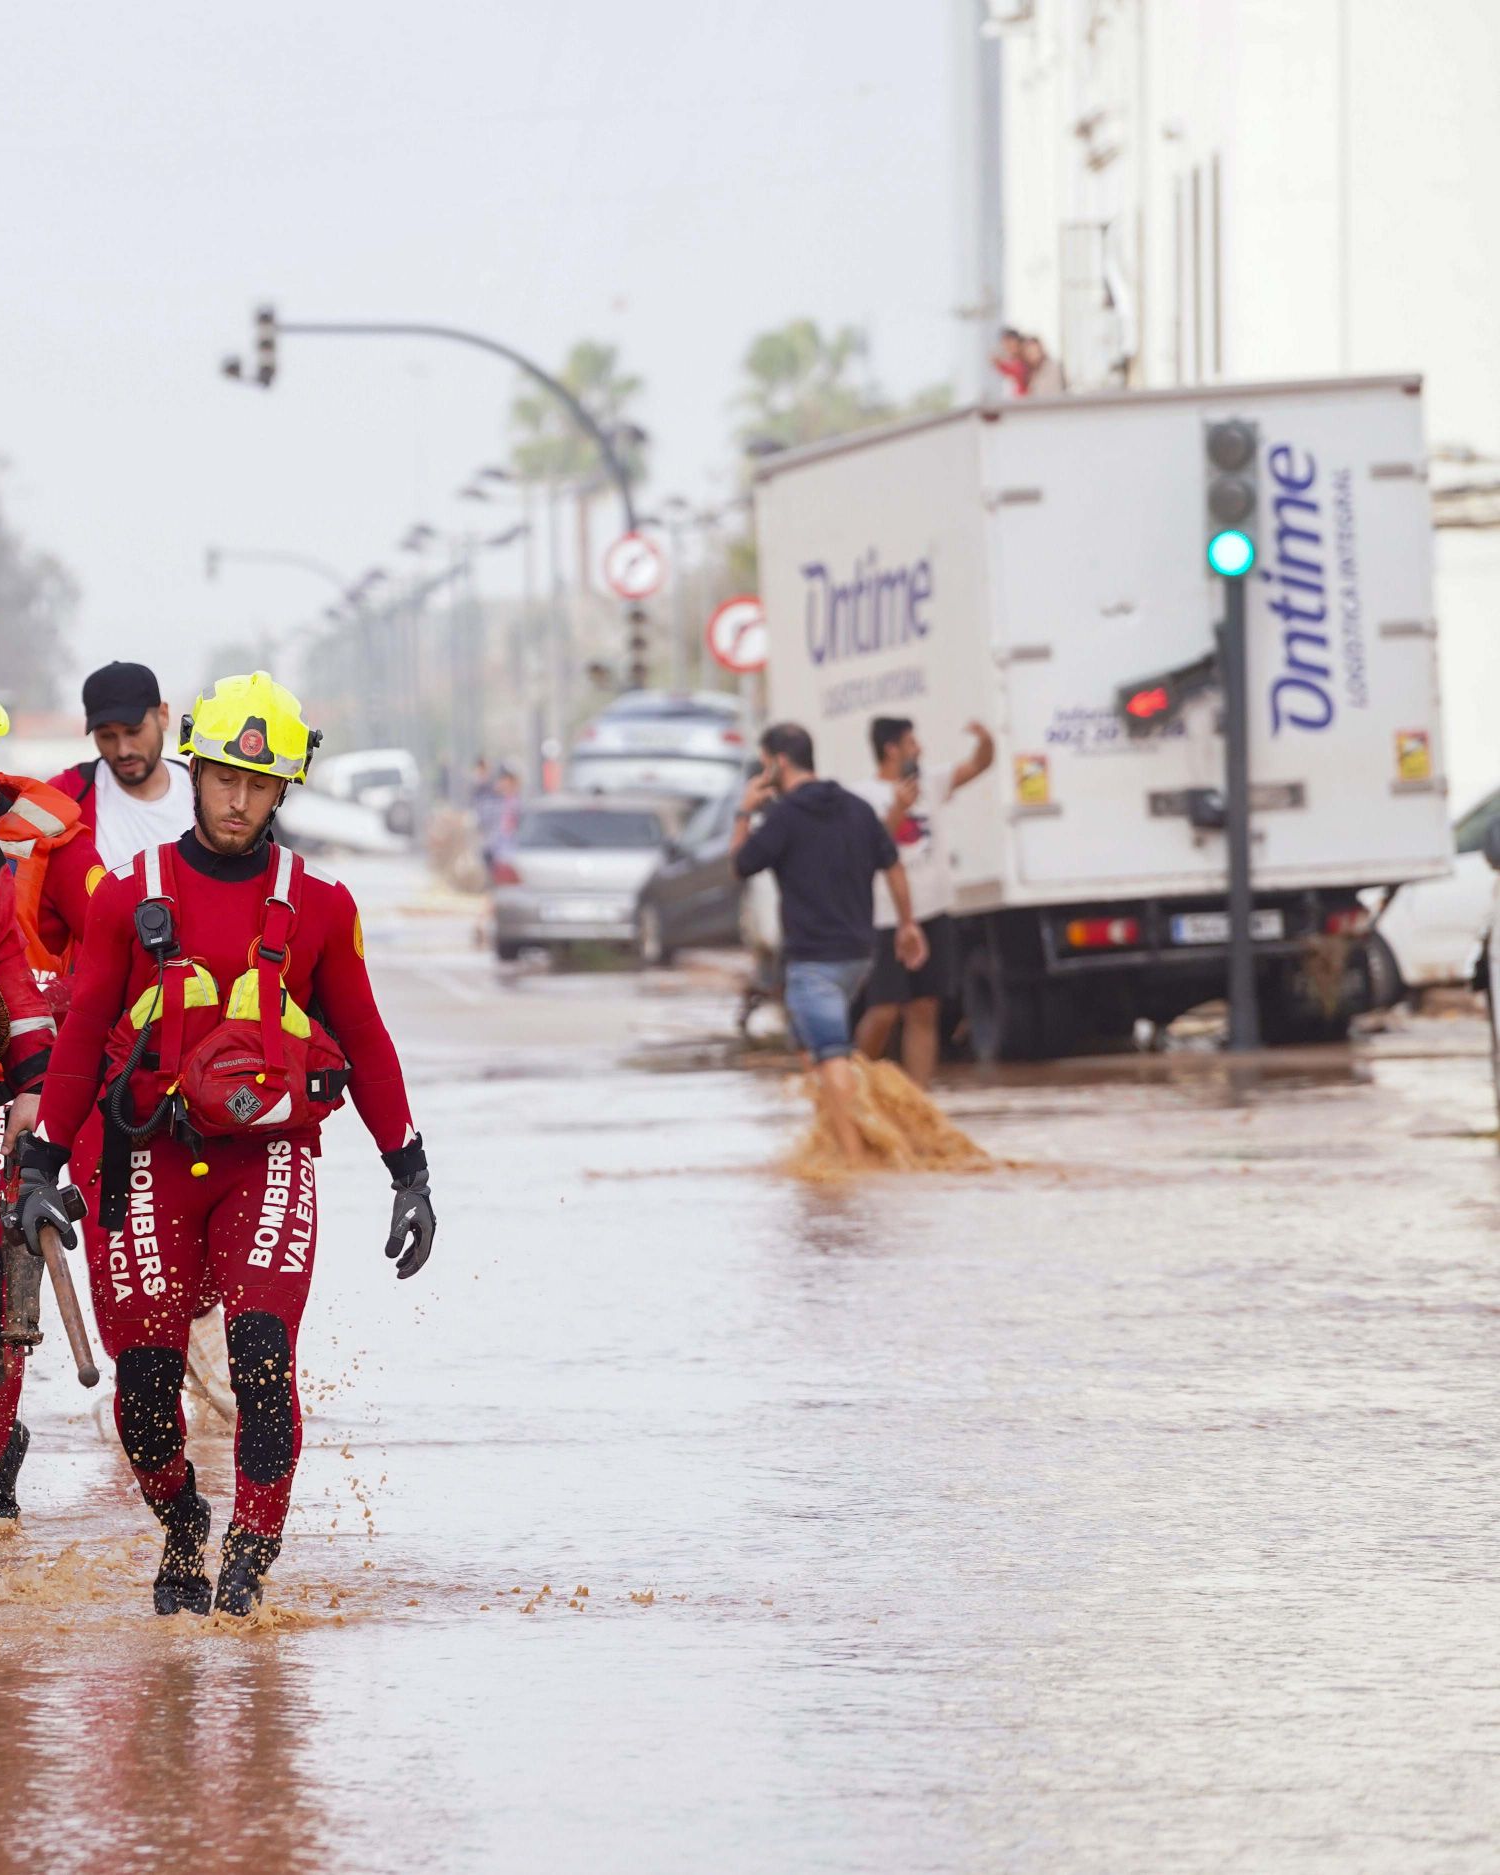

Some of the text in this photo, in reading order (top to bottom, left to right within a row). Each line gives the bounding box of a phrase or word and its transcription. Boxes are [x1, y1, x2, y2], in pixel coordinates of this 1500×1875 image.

[799, 546, 932, 666] Ontime
[1260, 444, 1333, 738] Ontime
[108, 1231, 134, 1304] NCIA
[130, 1150, 167, 1297] BOMBERS
[247, 1140, 292, 1269] BOMBERS
[279, 1146, 315, 1273] VALÈNCIA
